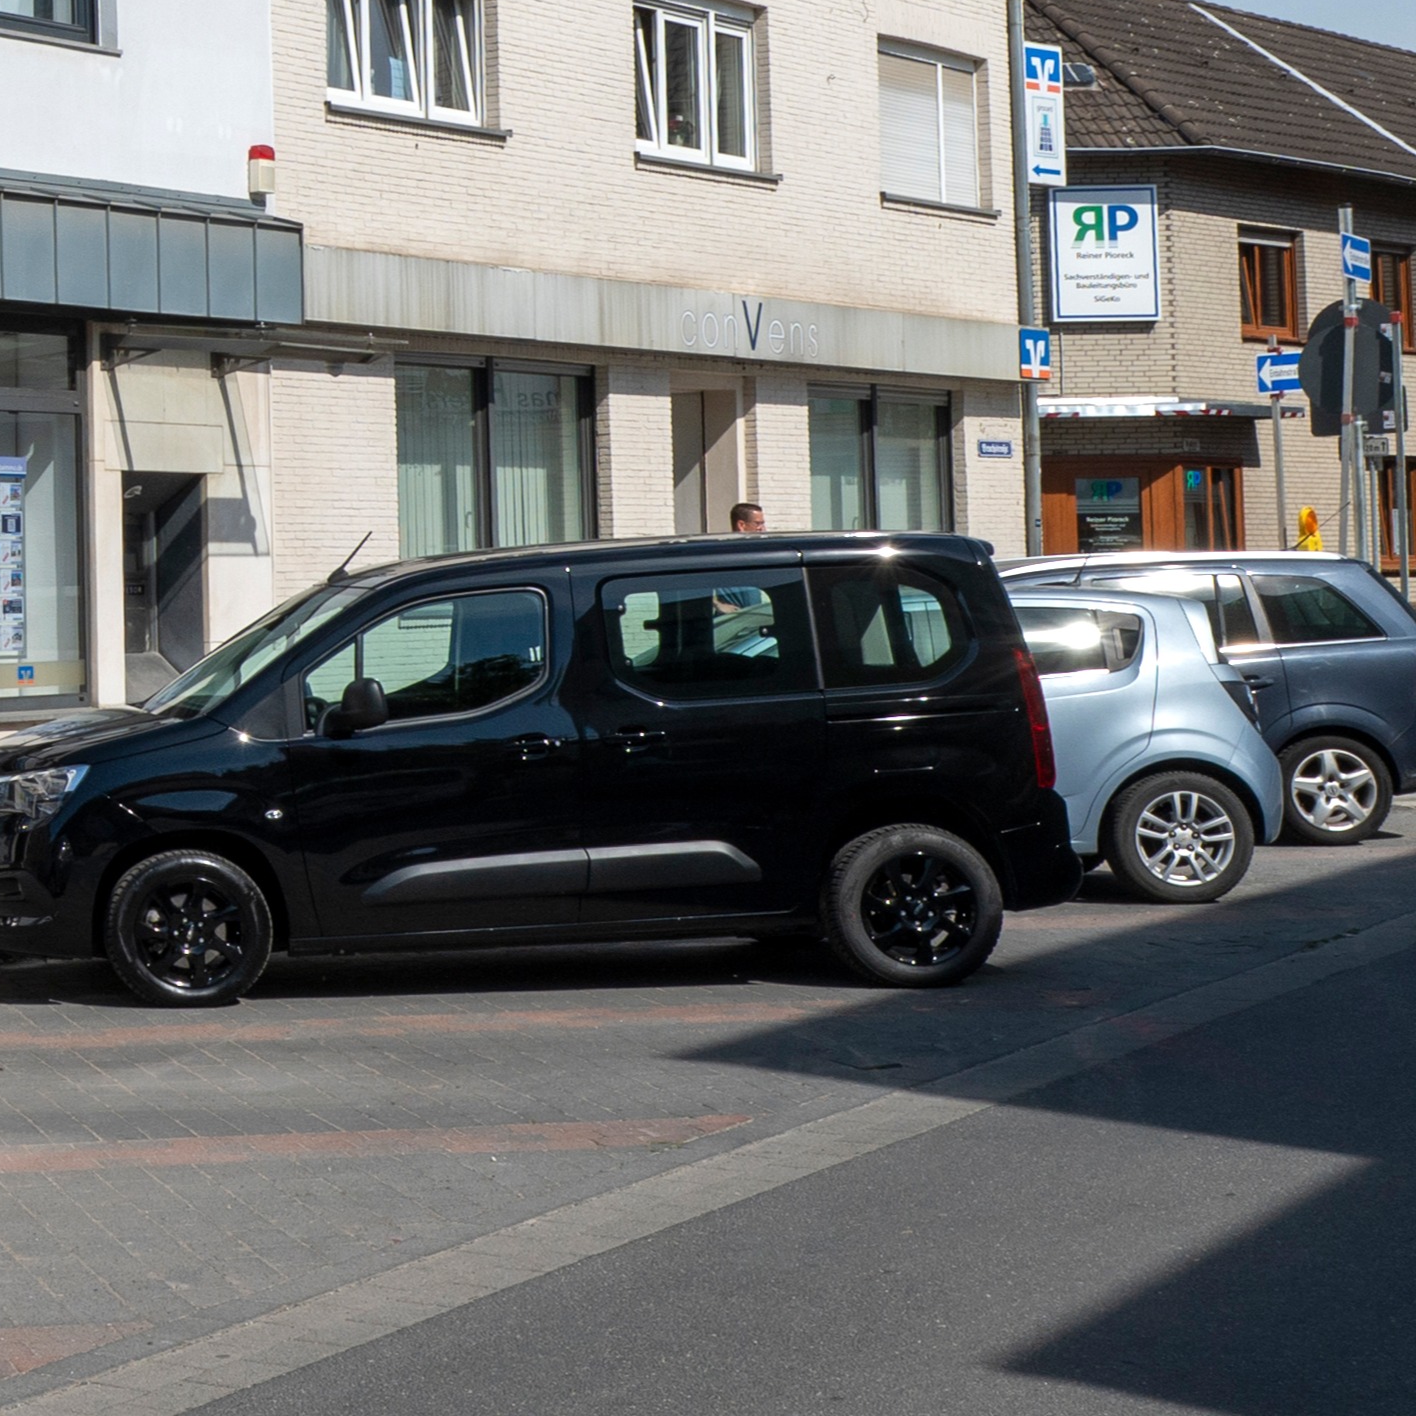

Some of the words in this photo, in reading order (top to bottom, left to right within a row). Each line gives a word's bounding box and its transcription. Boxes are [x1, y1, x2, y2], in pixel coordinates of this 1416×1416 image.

[1076, 251, 1103, 260] Reiner
[1105, 250, 1135, 260] Pioreck
[1063, 272, 1133, 282] Sachverständigen-
[1134, 272, 1150, 280] und
[1075, 281, 1138, 291] Bauleitungsbüro
[679, 299, 819, 359] conVens
